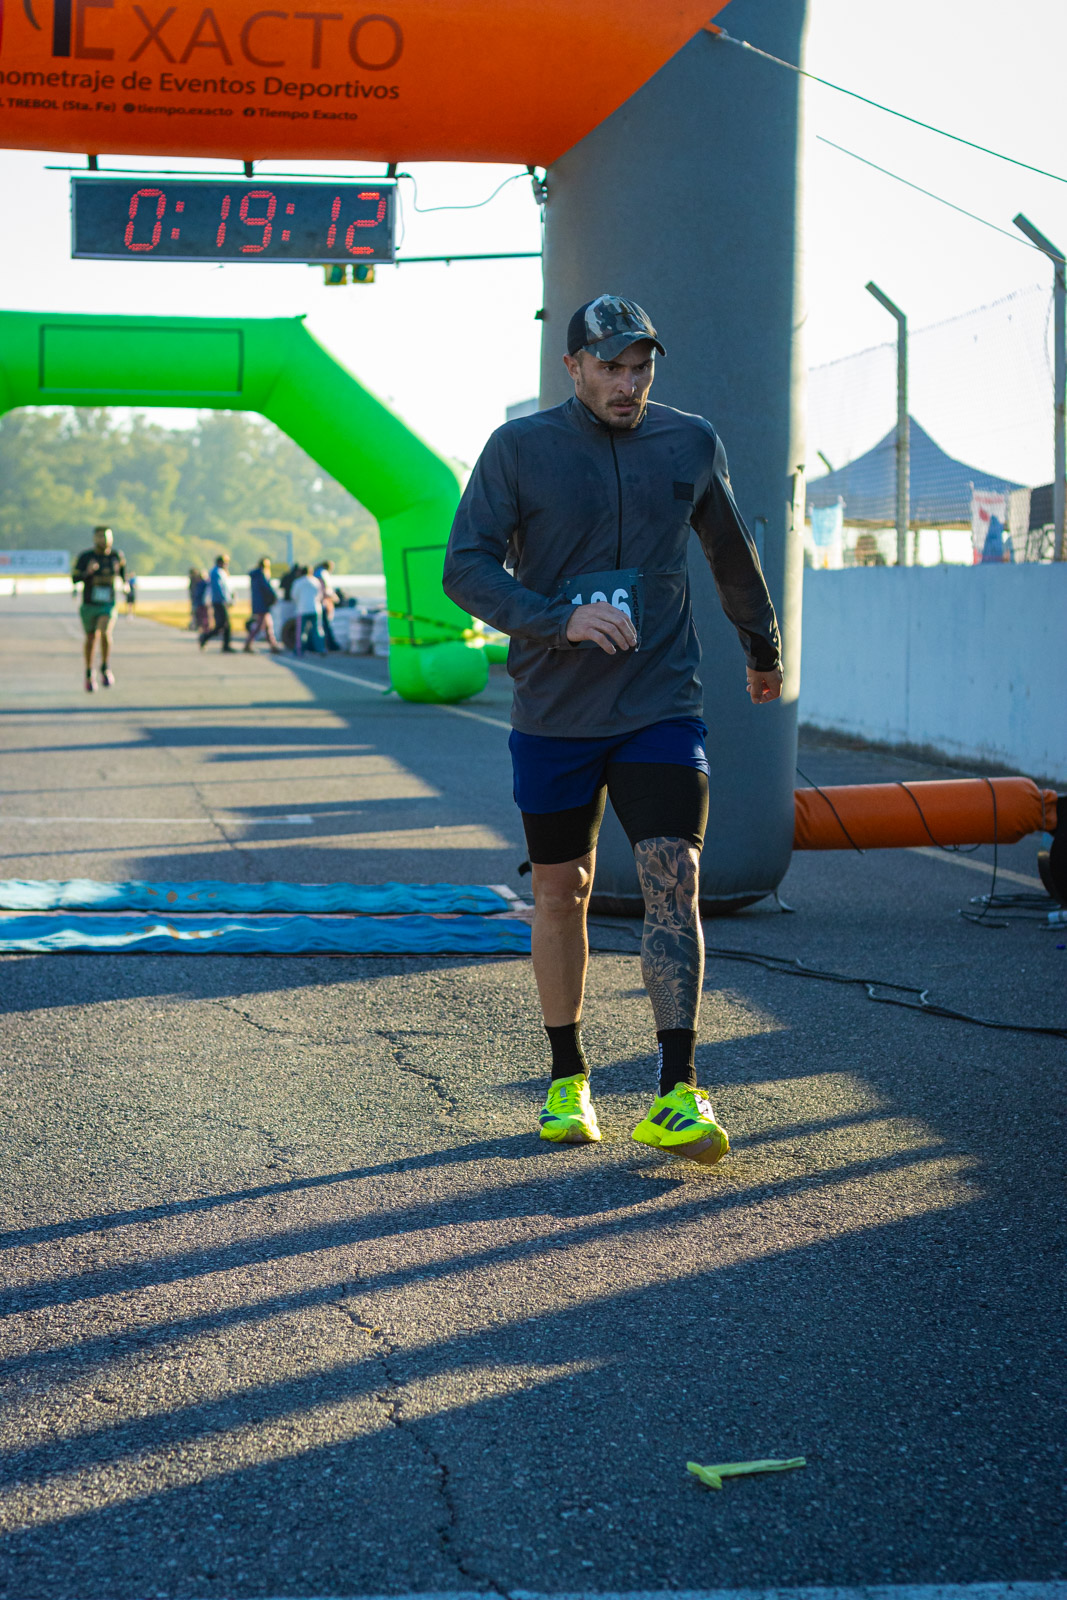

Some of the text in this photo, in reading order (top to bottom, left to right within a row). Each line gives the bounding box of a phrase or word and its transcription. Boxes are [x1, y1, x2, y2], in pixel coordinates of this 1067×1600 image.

[121, 70, 153, 91] de
[159, 72, 256, 95] Eventos
[263, 76, 400, 101] Deportivos
[96, 101, 116, 113] Fe)
[258, 107, 310, 120] Tiempo
[313, 109, 358, 121] Exacto
